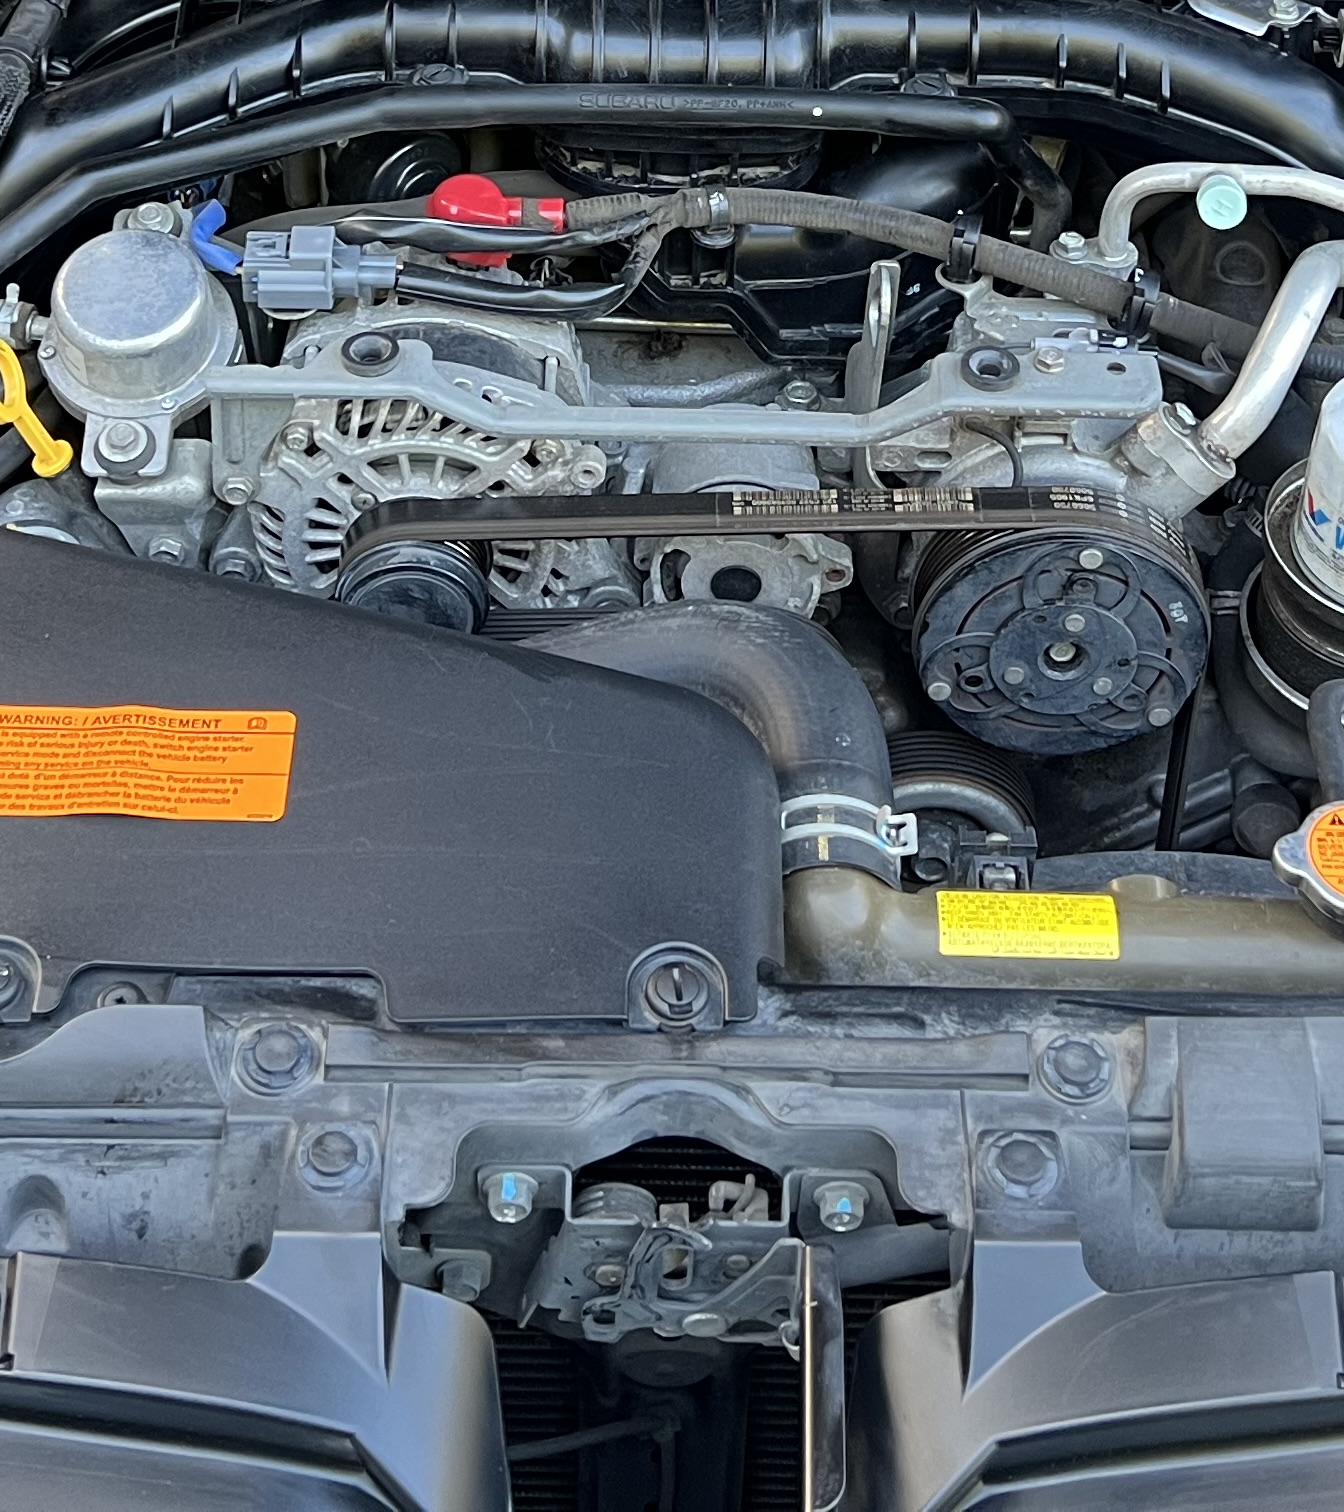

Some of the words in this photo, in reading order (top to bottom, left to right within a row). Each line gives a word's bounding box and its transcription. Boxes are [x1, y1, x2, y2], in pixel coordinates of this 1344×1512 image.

[579, 93, 676, 110] SUBARU
[92, 713, 223, 730] AVERTISSEMENT
[12, 731, 57, 740] equipped
[60, 731, 81, 739] with
[90, 730, 125, 739] remote
[126, 730, 176, 742] controlled
[178, 735, 210, 744] engine
[27, 740, 38, 748] of
[78, 740, 106, 749] injury
[120, 739, 150, 748] death,
[153, 742, 185, 752] switch
[186, 745, 219, 754] engine
[222, 745, 254, 753] starter
[32, 751, 60, 759] mode
[62, 751, 81, 759] and
[83, 749, 137, 758] disconnect
[138, 750, 154, 758] the
[157, 752, 191, 762] vehicle
[193, 754, 228, 764] battery
[24, 761, 41, 770] any
[96, 759, 112, 768] the
[166, 774, 191, 784] Pour
[192, 776, 228, 785] réduire
[32, 784, 65, 792] graves
[83, 780, 130, 789] mortelles,
[134, 783, 165, 791] mettre
[167, 785, 177, 793] le
[179, 786, 231, 795] démarreur
[53, 792, 63, 800] et
[65, 790, 121, 800] débrancher
[122, 790, 132, 799] la
[134, 792, 172, 803] batterie
[174, 796, 187, 804] du
[189, 796, 231, 805] véhicule
[8, 802, 26, 810] des
[29, 803, 65, 811] travaux
